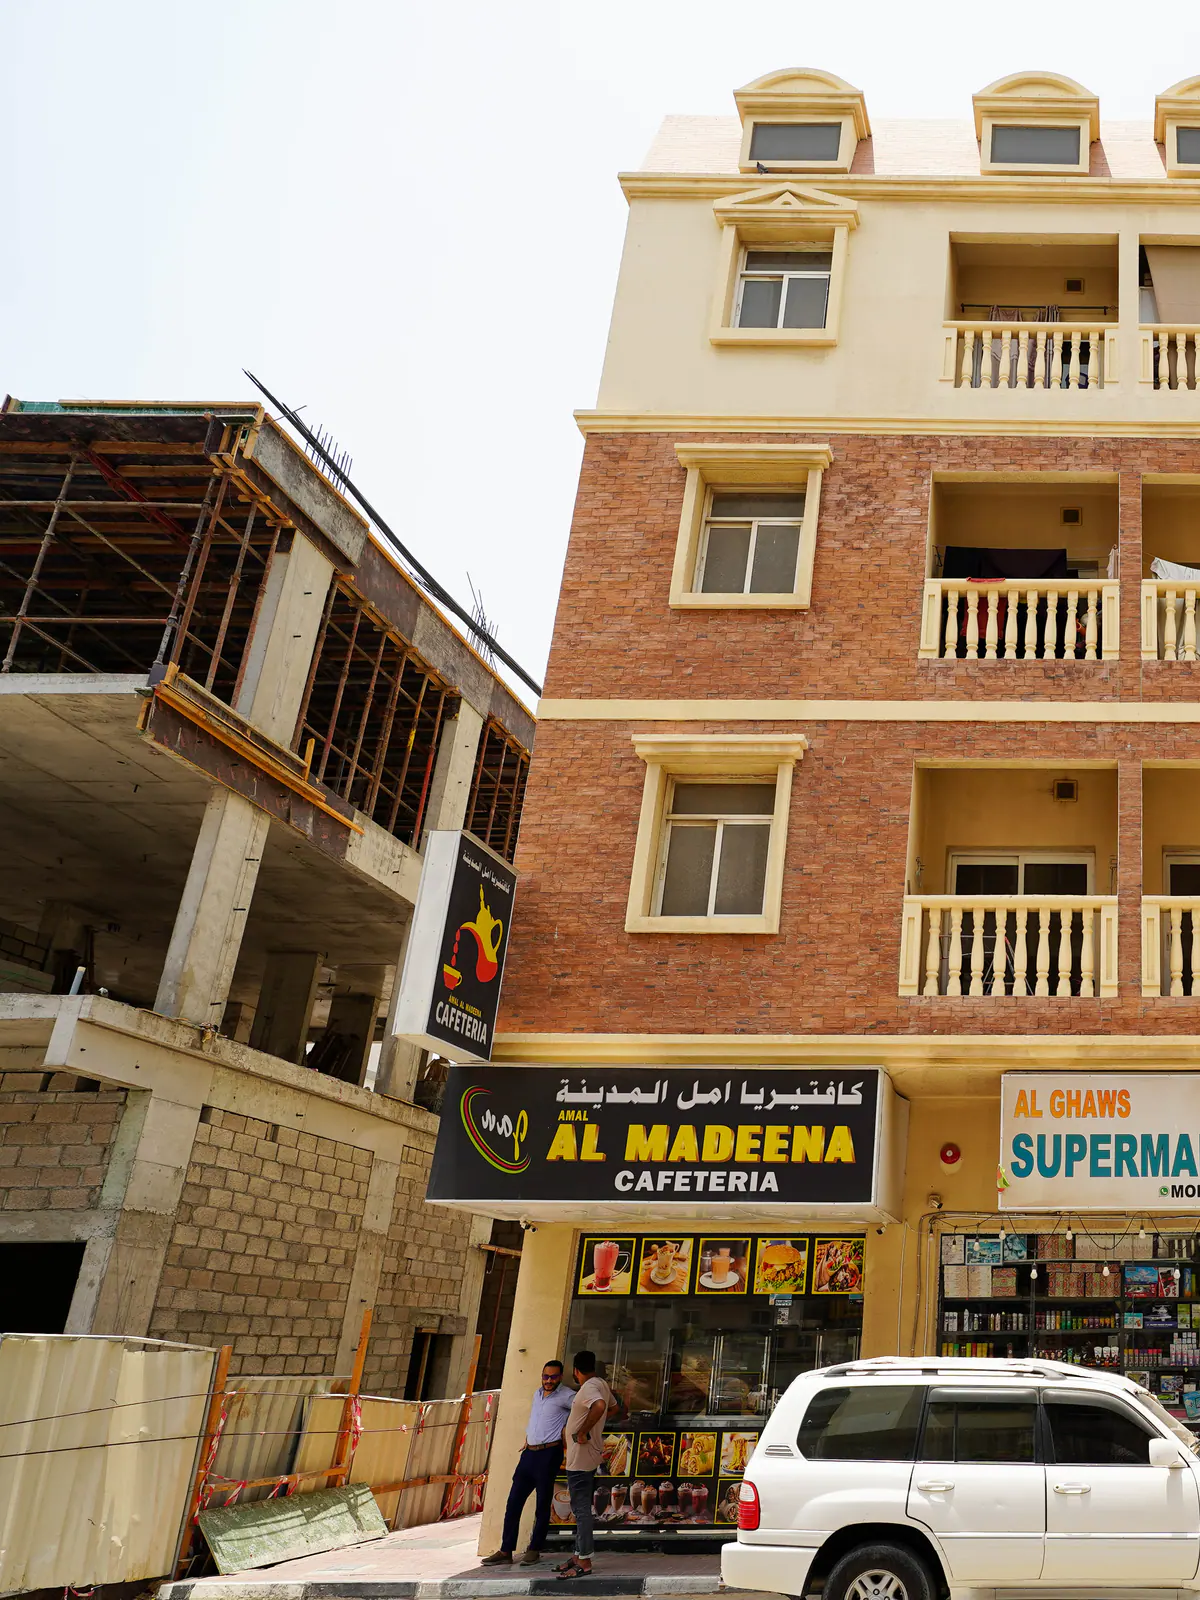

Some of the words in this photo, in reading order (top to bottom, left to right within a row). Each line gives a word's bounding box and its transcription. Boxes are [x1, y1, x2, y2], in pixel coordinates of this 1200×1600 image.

[462, 849, 483, 872] المدينة
[435, 1001, 488, 1045] CAFETERIA
[555, 1079, 669, 1111] المدينة
[676, 1080, 732, 1110] امل
[740, 1080, 864, 1111] كافتيريا
[1013, 1089, 1044, 1119] AL
[1049, 1089, 1132, 1119] GHAWS
[557, 1109, 589, 1122] AMAL
[546, 1123, 607, 1162] AL
[624, 1124, 857, 1164] MADEENA
[614, 1170, 780, 1192] CAFETERIA
